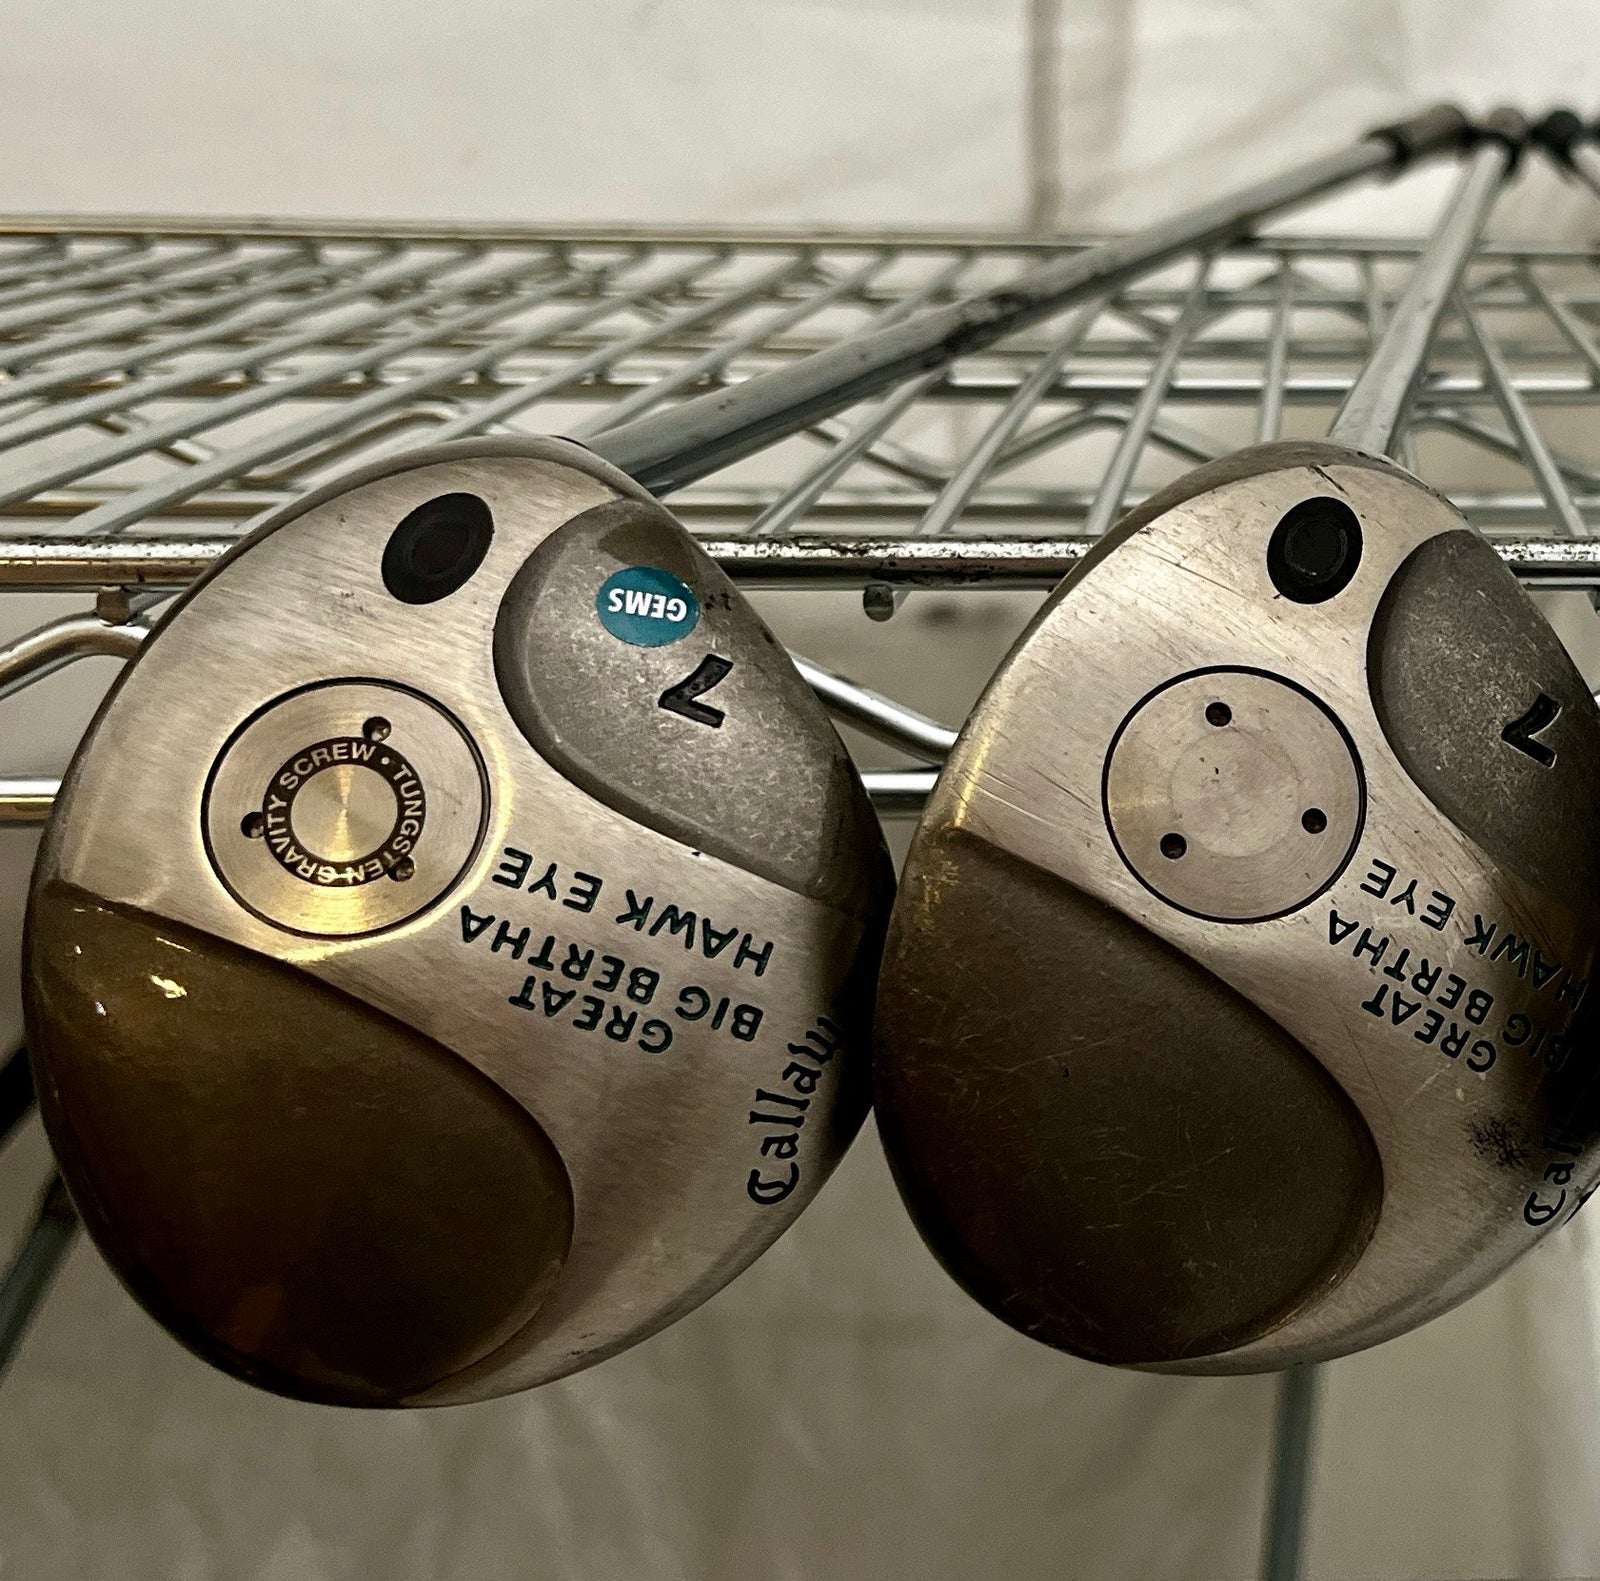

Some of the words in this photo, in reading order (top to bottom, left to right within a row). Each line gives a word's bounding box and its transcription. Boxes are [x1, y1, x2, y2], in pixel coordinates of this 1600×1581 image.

[608, 588, 687, 622] GEMS
[658, 653, 734, 728] 7
[279, 742, 377, 790] SCREW
[1500, 692, 1562, 769] 7
[492, 847, 603, 913] EYE
[1360, 858, 1456, 932] EYE
[460, 904, 660, 1005] BERTHA
[615, 889, 774, 977] HAWK
[1329, 909, 1494, 1026] BERTHA
[1464, 914, 1589, 1013] HAWK
[508, 975, 673, 1054] GREAT
[674, 985, 764, 1042] BIG
[1361, 983, 1497, 1073] GREAT
[1502, 1012, 1571, 1072] BIG
[747, 1016, 841, 1205] Callaw
